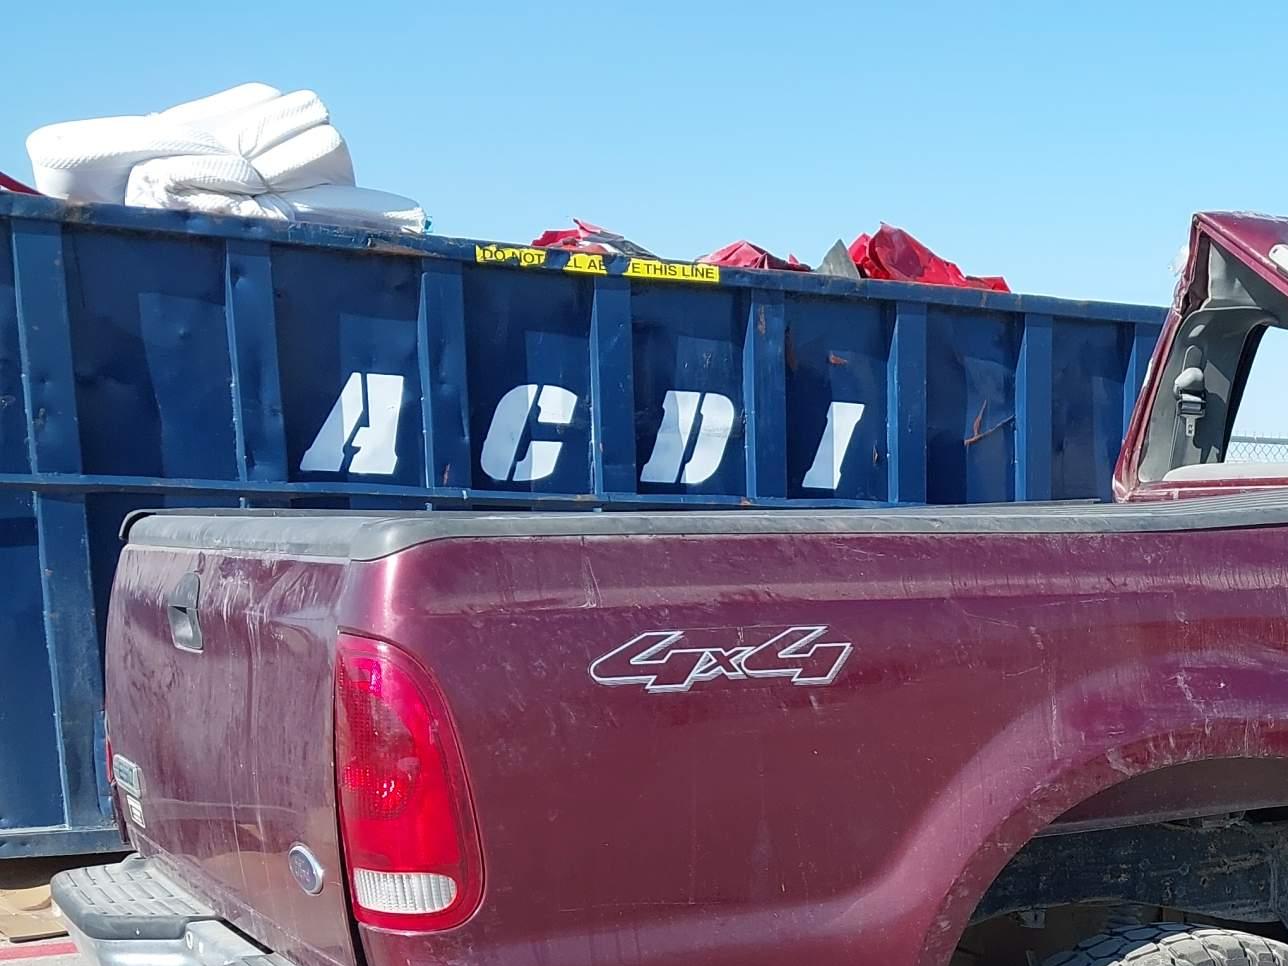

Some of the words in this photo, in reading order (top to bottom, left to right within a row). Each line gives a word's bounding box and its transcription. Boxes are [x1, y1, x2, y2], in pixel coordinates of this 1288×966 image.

[482, 248, 506, 261] DO
[511, 250, 545, 265] NOT
[644, 263, 677, 277] THIS
[682, 266, 715, 280] LINE
[588, 624, 853, 693] 4x4
